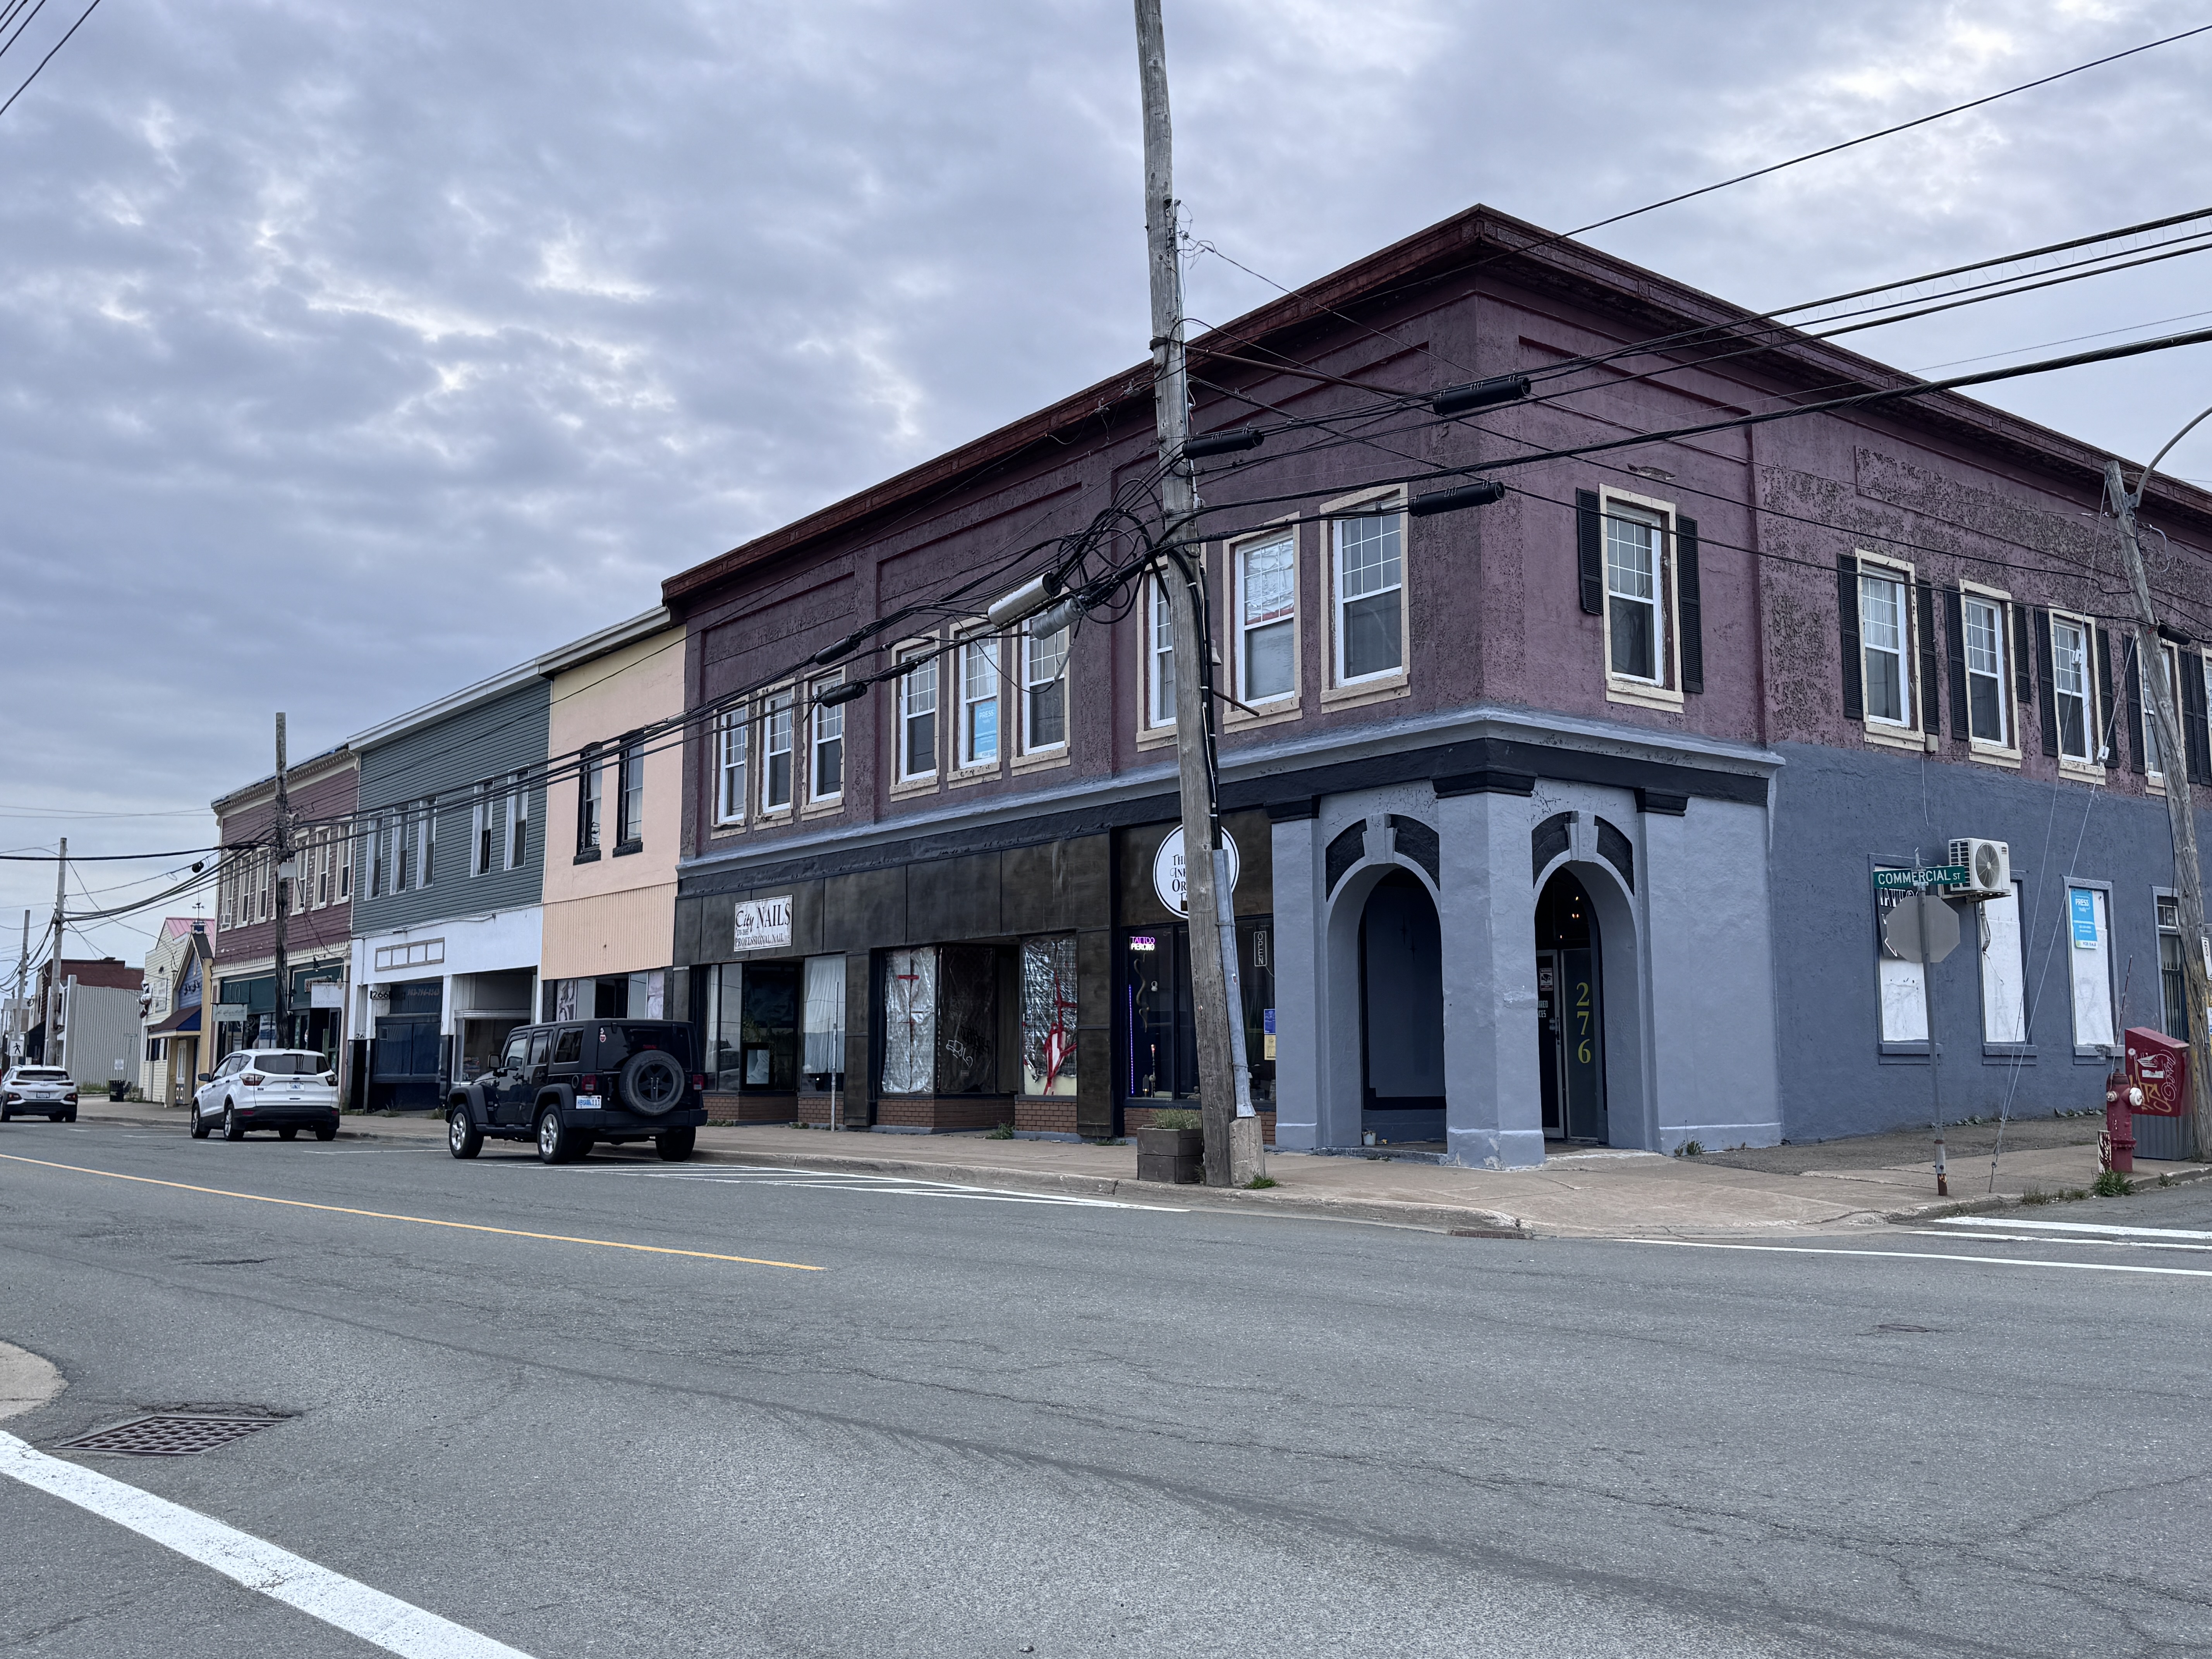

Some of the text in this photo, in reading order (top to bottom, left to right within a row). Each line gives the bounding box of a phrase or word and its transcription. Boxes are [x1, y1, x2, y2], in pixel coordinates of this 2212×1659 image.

[979, 709, 994, 719] PRESS
[1878, 869, 1951, 885] COMMERCIAL
[736, 903, 790, 933] City NAILS
[1577, 982, 1591, 1063] 276
